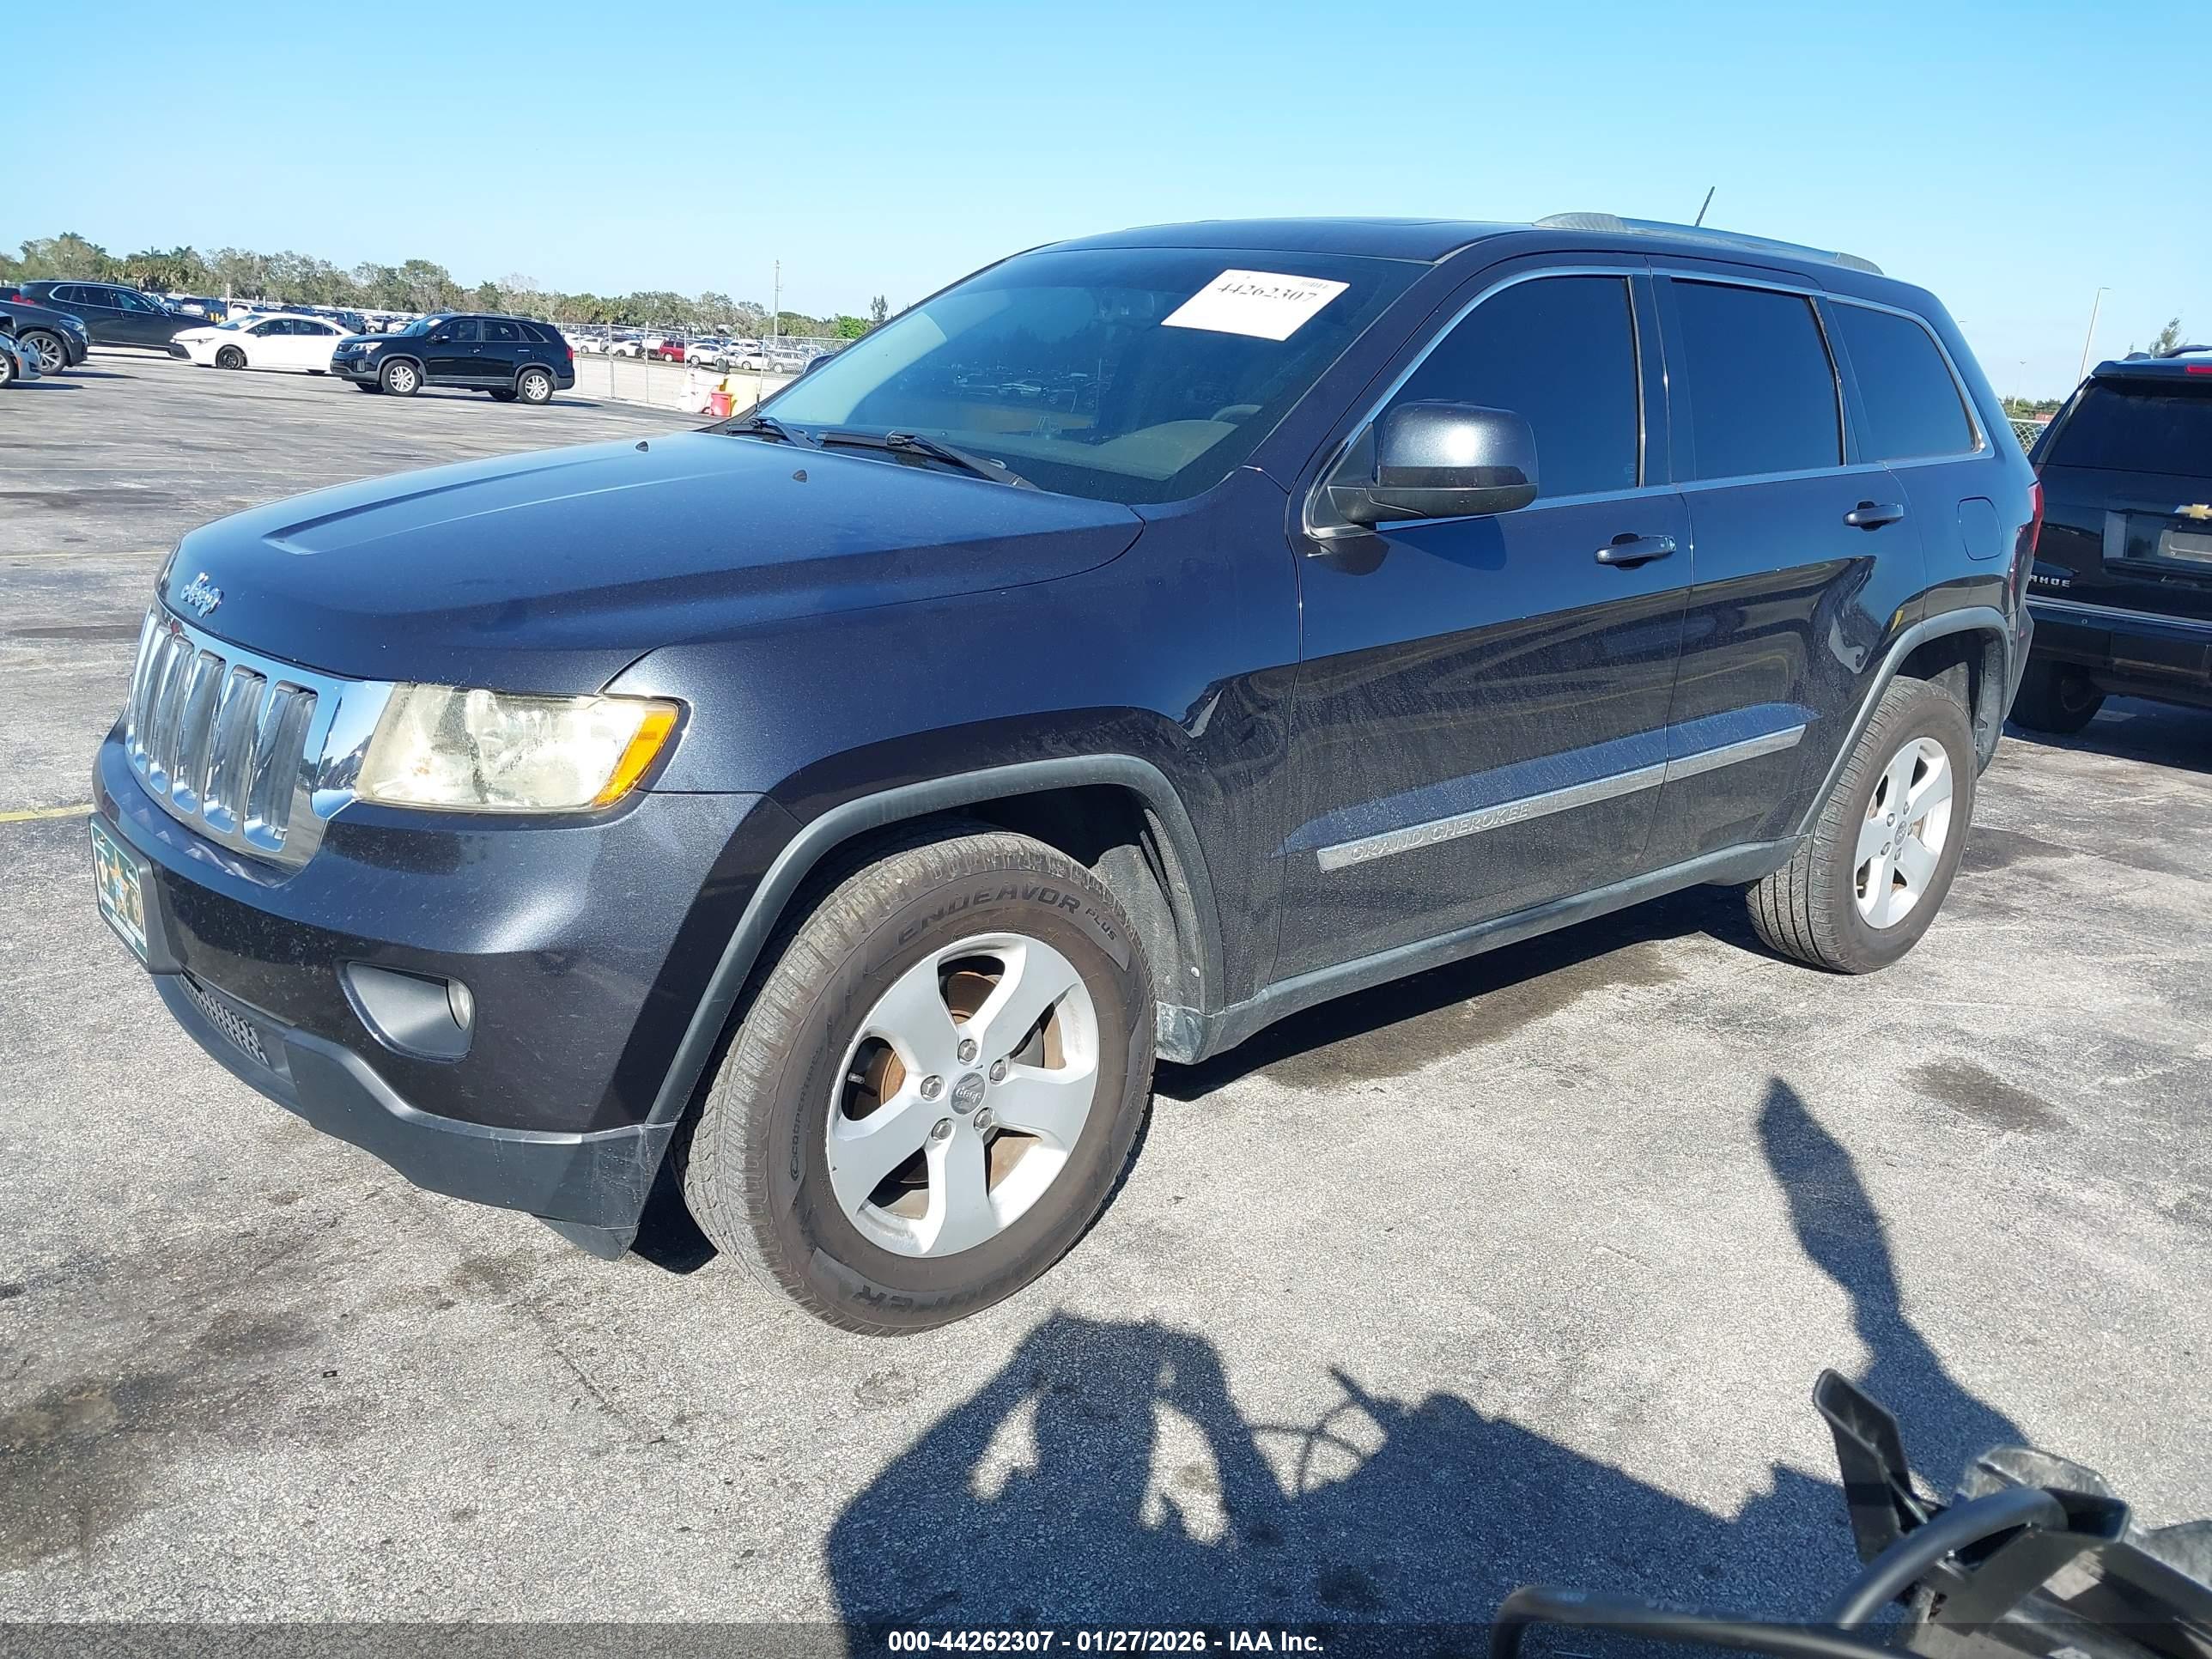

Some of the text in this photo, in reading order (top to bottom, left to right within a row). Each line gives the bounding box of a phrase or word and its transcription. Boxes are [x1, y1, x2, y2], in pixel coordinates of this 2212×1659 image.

[1217, 283, 1318, 302] 44262307
[180, 572, 221, 617] Jeep
[2029, 574, 2071, 588] AHOE
[1351, 803, 1531, 860] GRAND CHEROKEE
[896, 883, 1118, 945] ENDEAVOR PLUS
